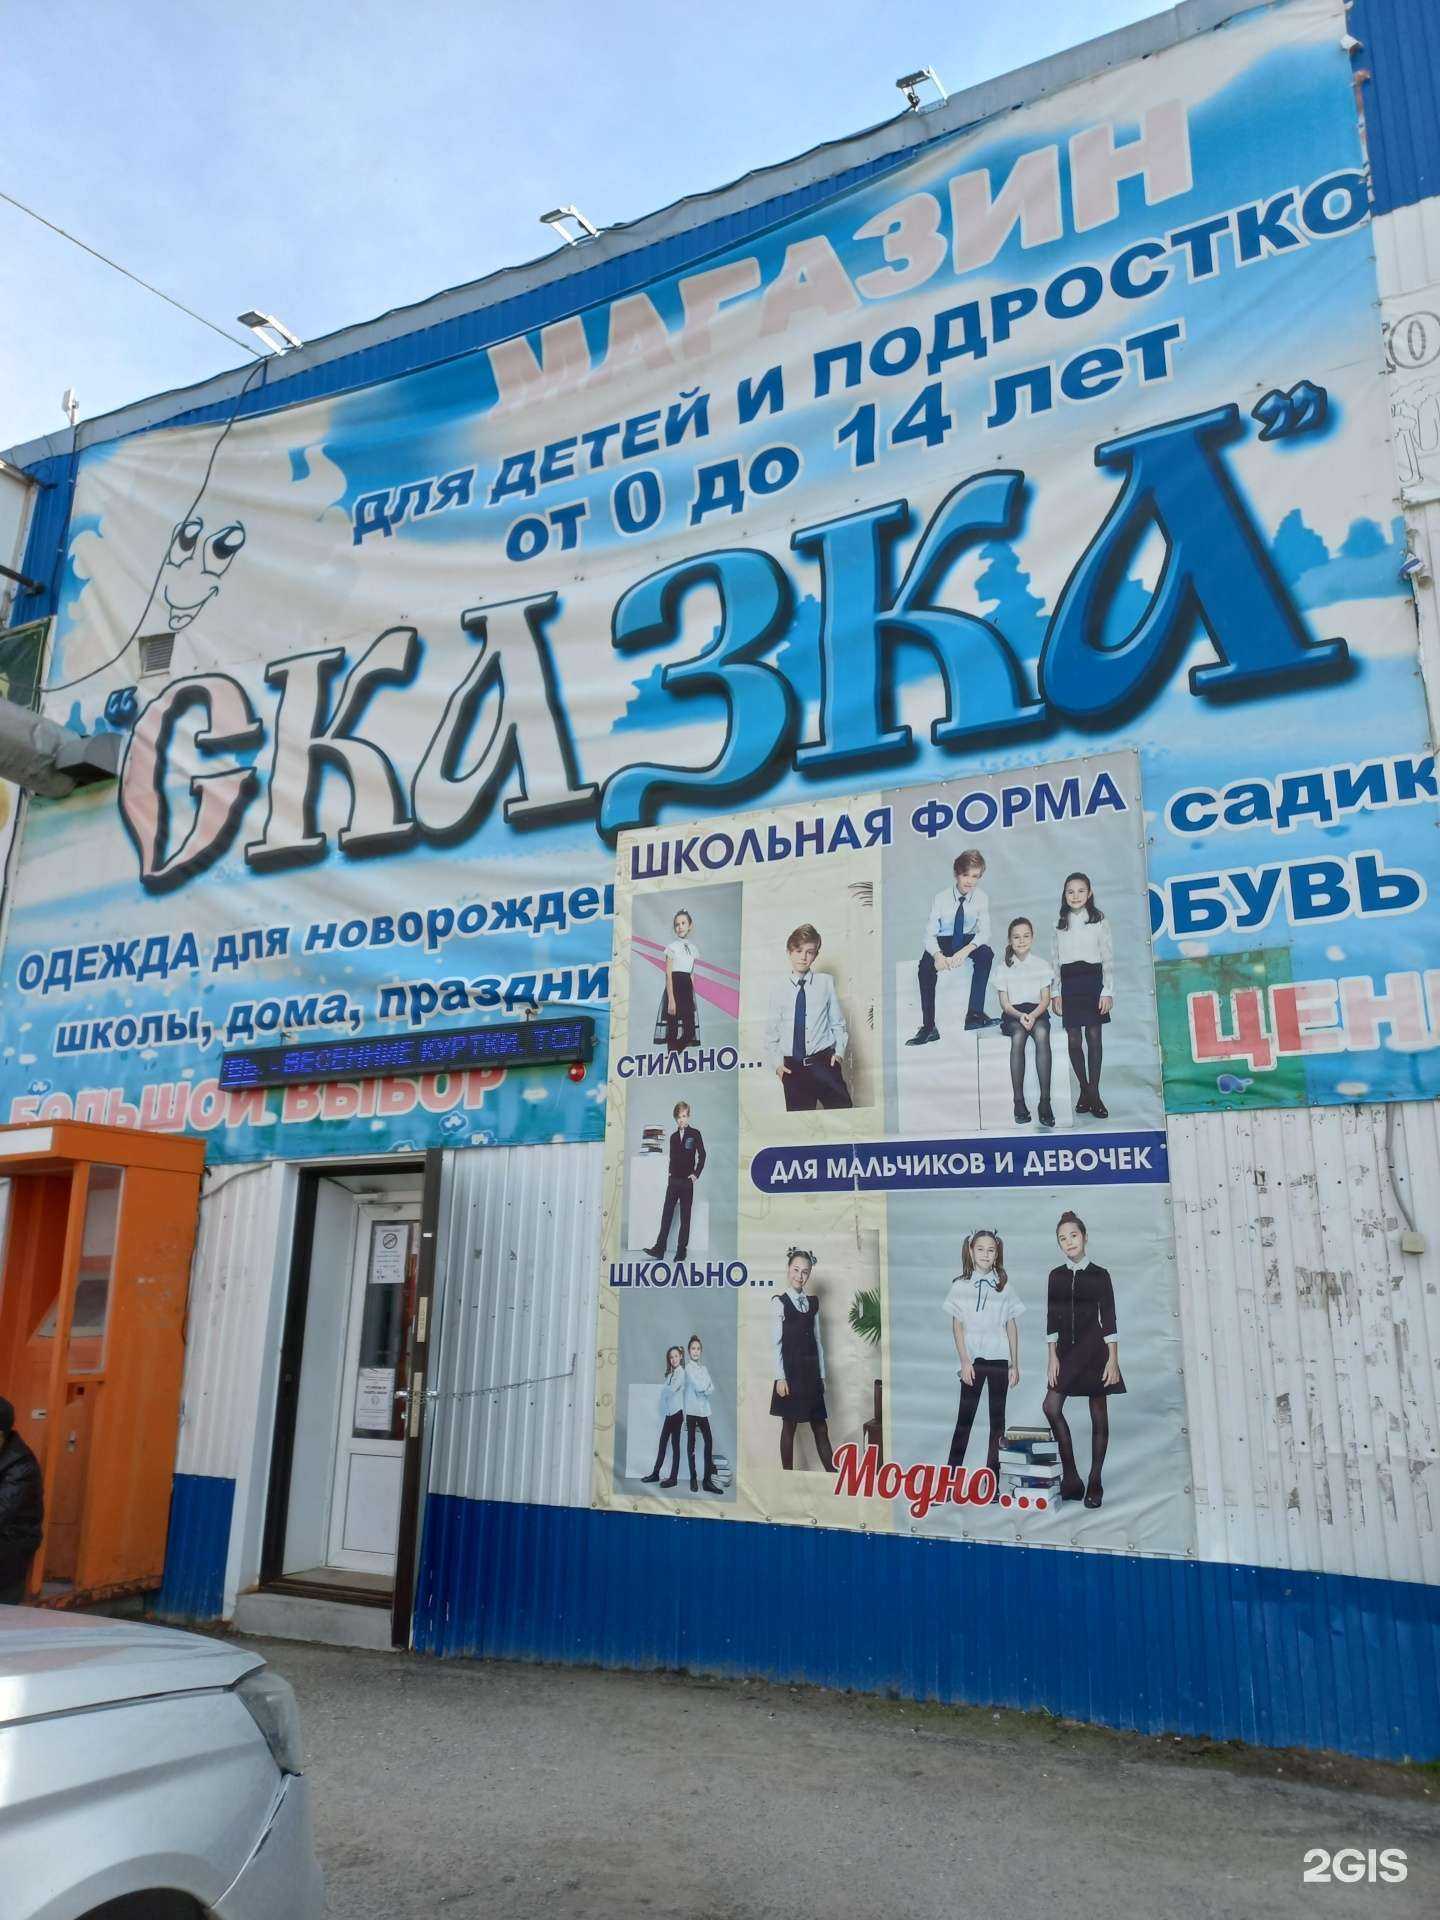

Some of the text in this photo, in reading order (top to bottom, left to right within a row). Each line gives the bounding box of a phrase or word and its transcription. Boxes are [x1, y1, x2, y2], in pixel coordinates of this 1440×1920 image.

[487, 99, 1193, 416] МАГАЗИН
[352, 469, 474, 545] ДЛЯ
[490, 388, 710, 503] ДЕТЕЙ
[737, 365, 784, 424] И
[813, 172, 1370, 397] ПОДРОСТКО
[506, 323, 1180, 562] от 0 до 14 лет
[631, 772, 1126, 880] ШКОЛЬНАЯ ФОРМА
[1151, 856, 1421, 936] БУВЬ
[18, 931, 199, 994] ОДЕЖДА
[212, 927, 289, 975] для
[56, 1012, 213, 1053] школы,
[226, 992, 361, 1042] дома,
[283, 1065, 506, 1121] ВЫБОР
[616, 1046, 763, 1078] СТИЛЬНО...
[770, 1146, 1153, 1184] ДЛЯ МАЛЬЧИКОВ И ДЕВОЧЕК
[610, 1261, 774, 1288] ШКОЛЬНО...
[832, 1444, 1048, 1518] Модно...
